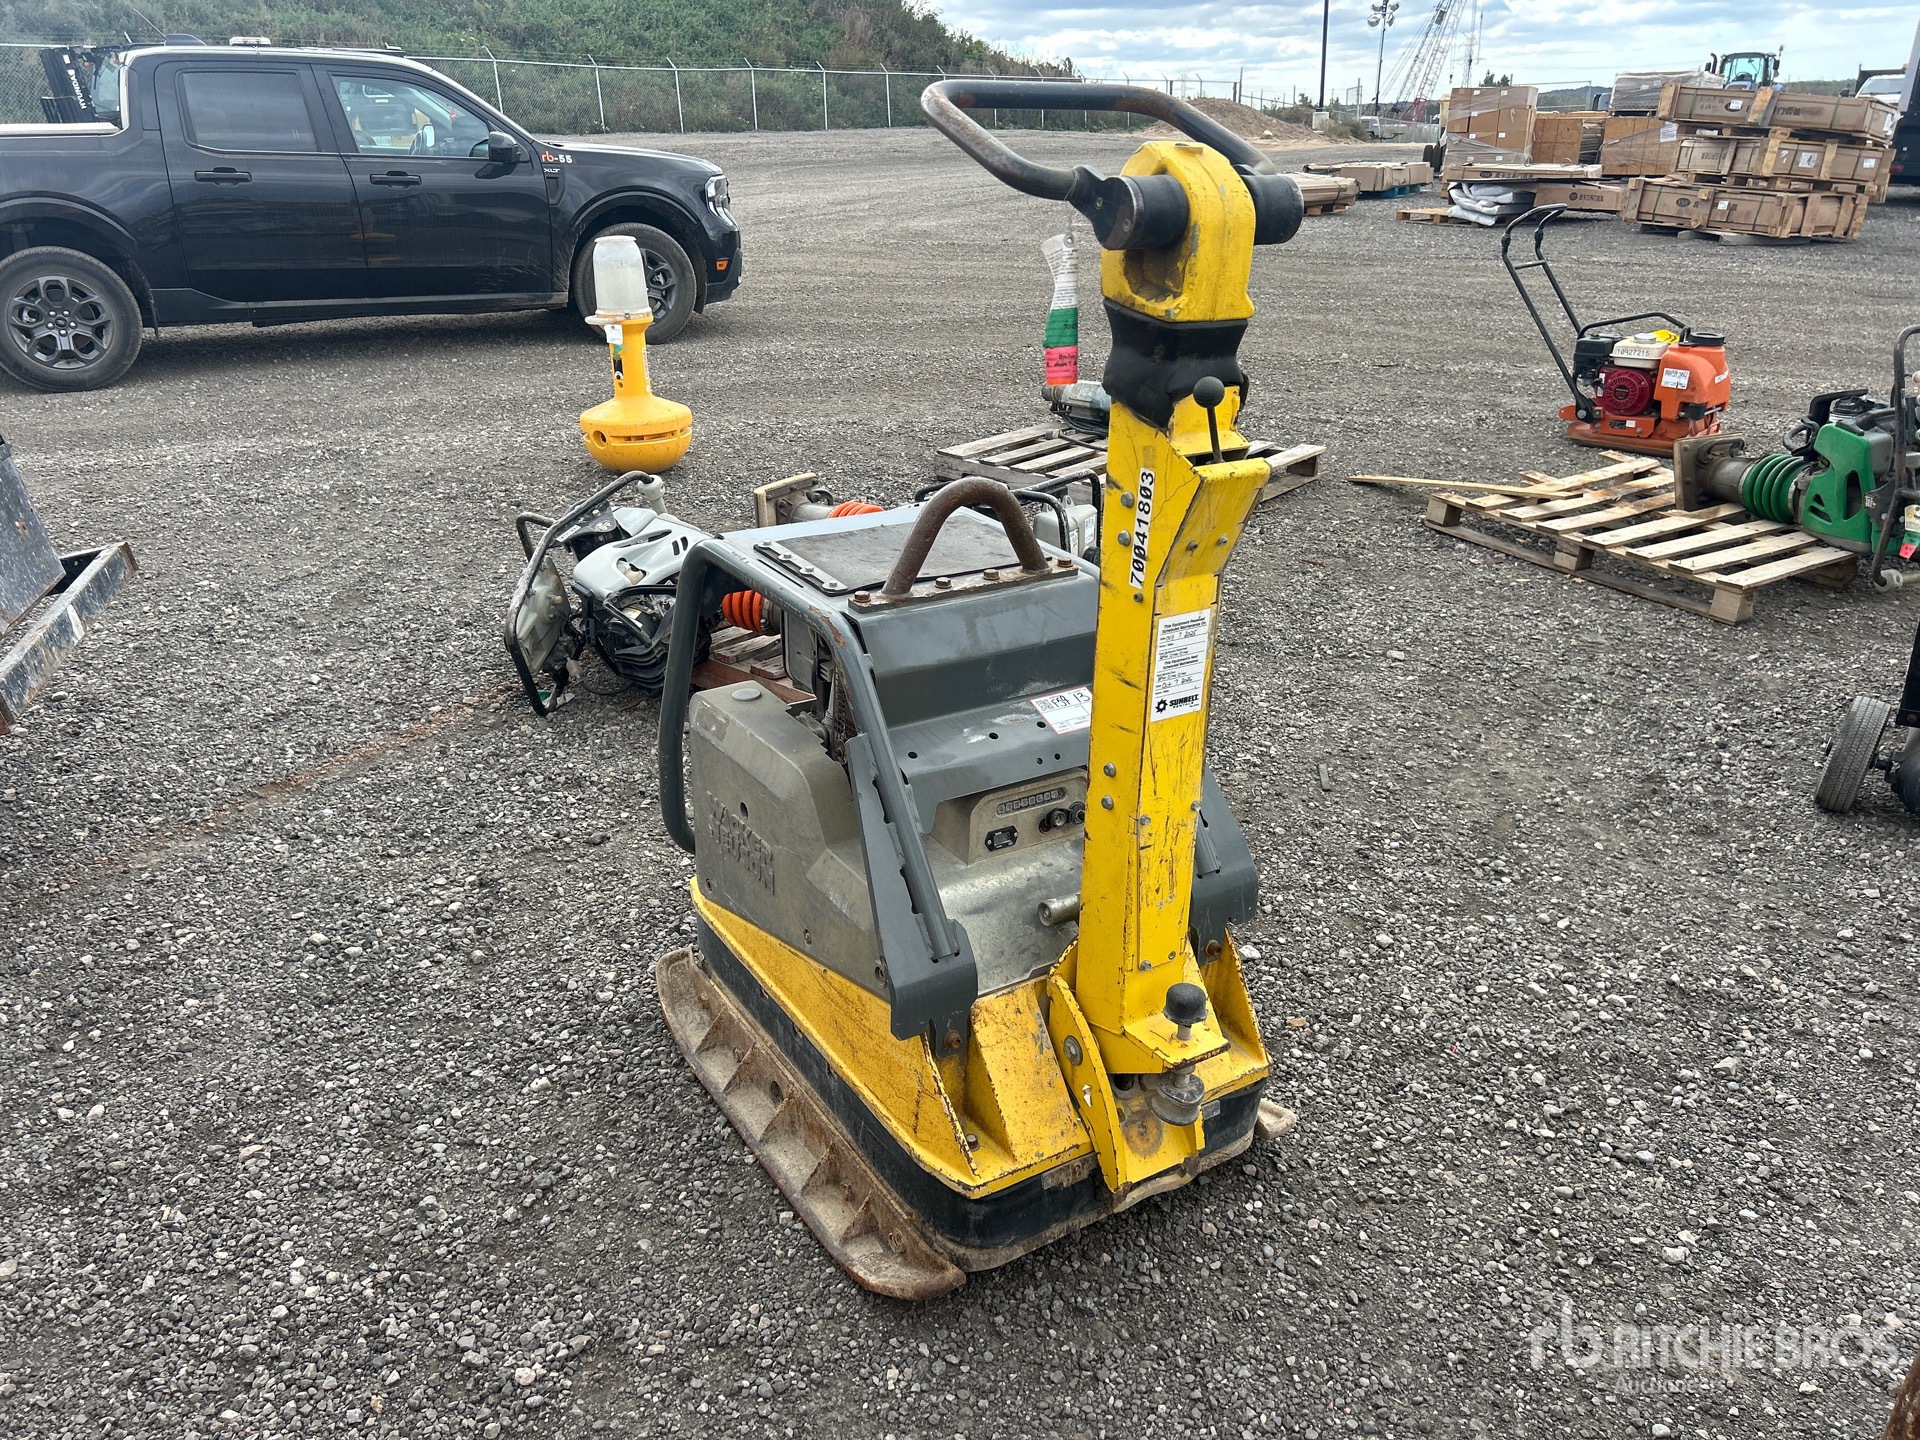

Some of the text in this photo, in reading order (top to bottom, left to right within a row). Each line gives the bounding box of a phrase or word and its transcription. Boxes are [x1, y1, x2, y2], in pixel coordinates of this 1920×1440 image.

[68, 69, 87, 110] HYUNDA
[1130, 470, 1154, 587] 70041803
[1169, 694, 1199, 707] SUNBELT
